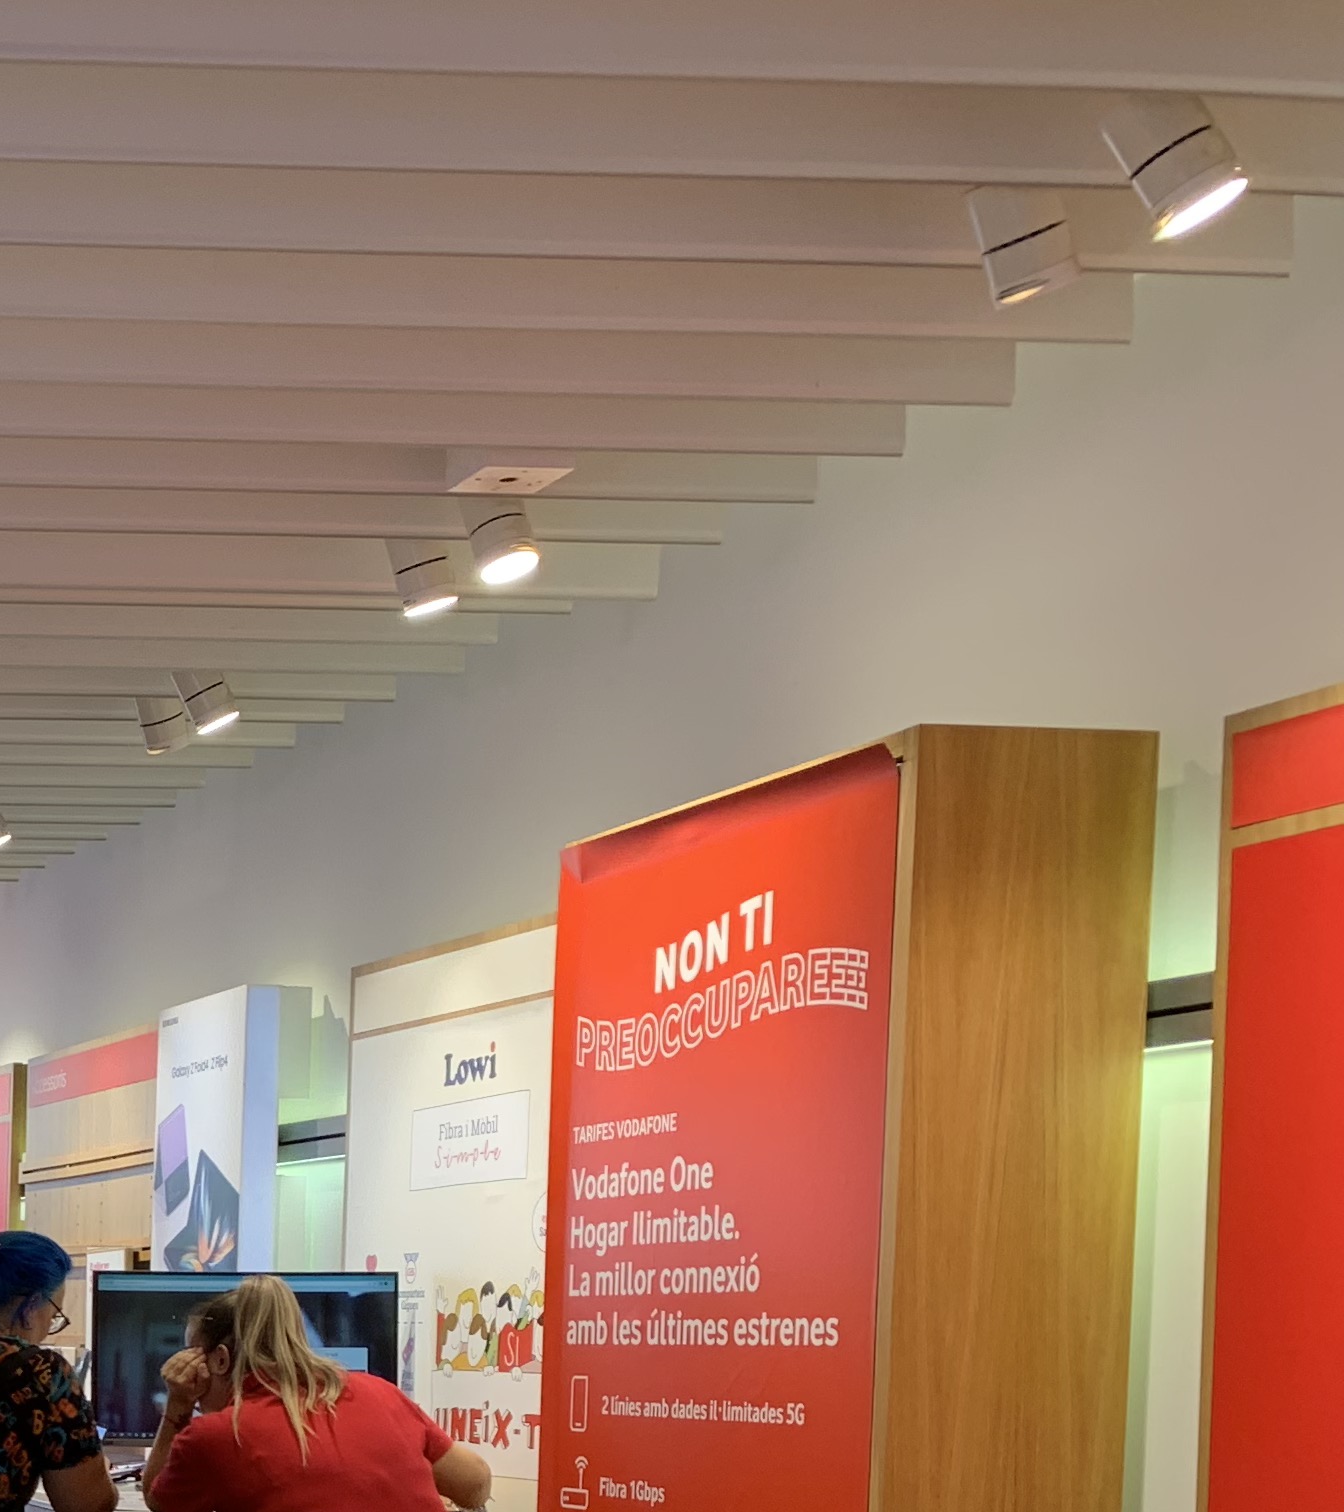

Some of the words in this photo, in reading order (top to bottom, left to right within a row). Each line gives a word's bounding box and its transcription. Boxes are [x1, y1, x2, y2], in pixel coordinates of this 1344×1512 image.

[654, 911, 730, 994] NON
[739, 889, 774, 952] TI
[444, 1041, 497, 1087] Lowi
[438, 1122, 463, 1141] Fibra
[573, 1122, 615, 1145] TARIFES
[616, 1112, 678, 1140] VODAFONE
[572, 1162, 665, 1200] Vodafone
[670, 1156, 714, 1192] One
[570, 1216, 629, 1256] Hogar
[632, 1204, 740, 1246] Ilimitable.
[568, 1264, 591, 1297] La
[595, 1261, 656, 1296] millor
[659, 1253, 760, 1295] connexió
[566, 1311, 608, 1346] amb
[613, 1311, 642, 1346] les
[646, 1308, 729, 1346] últimes
[733, 1312, 839, 1347] estrenes
[601, 1395, 609, 1415] 2
[611, 1395, 641, 1417] línies
[643, 1398, 669, 1419] amb
[671, 1398, 707, 1420] dades
[786, 1403, 805, 1426] 5G
[599, 1477, 627, 1500] Fibra
[629, 1480, 665, 1507] 1Gbps
